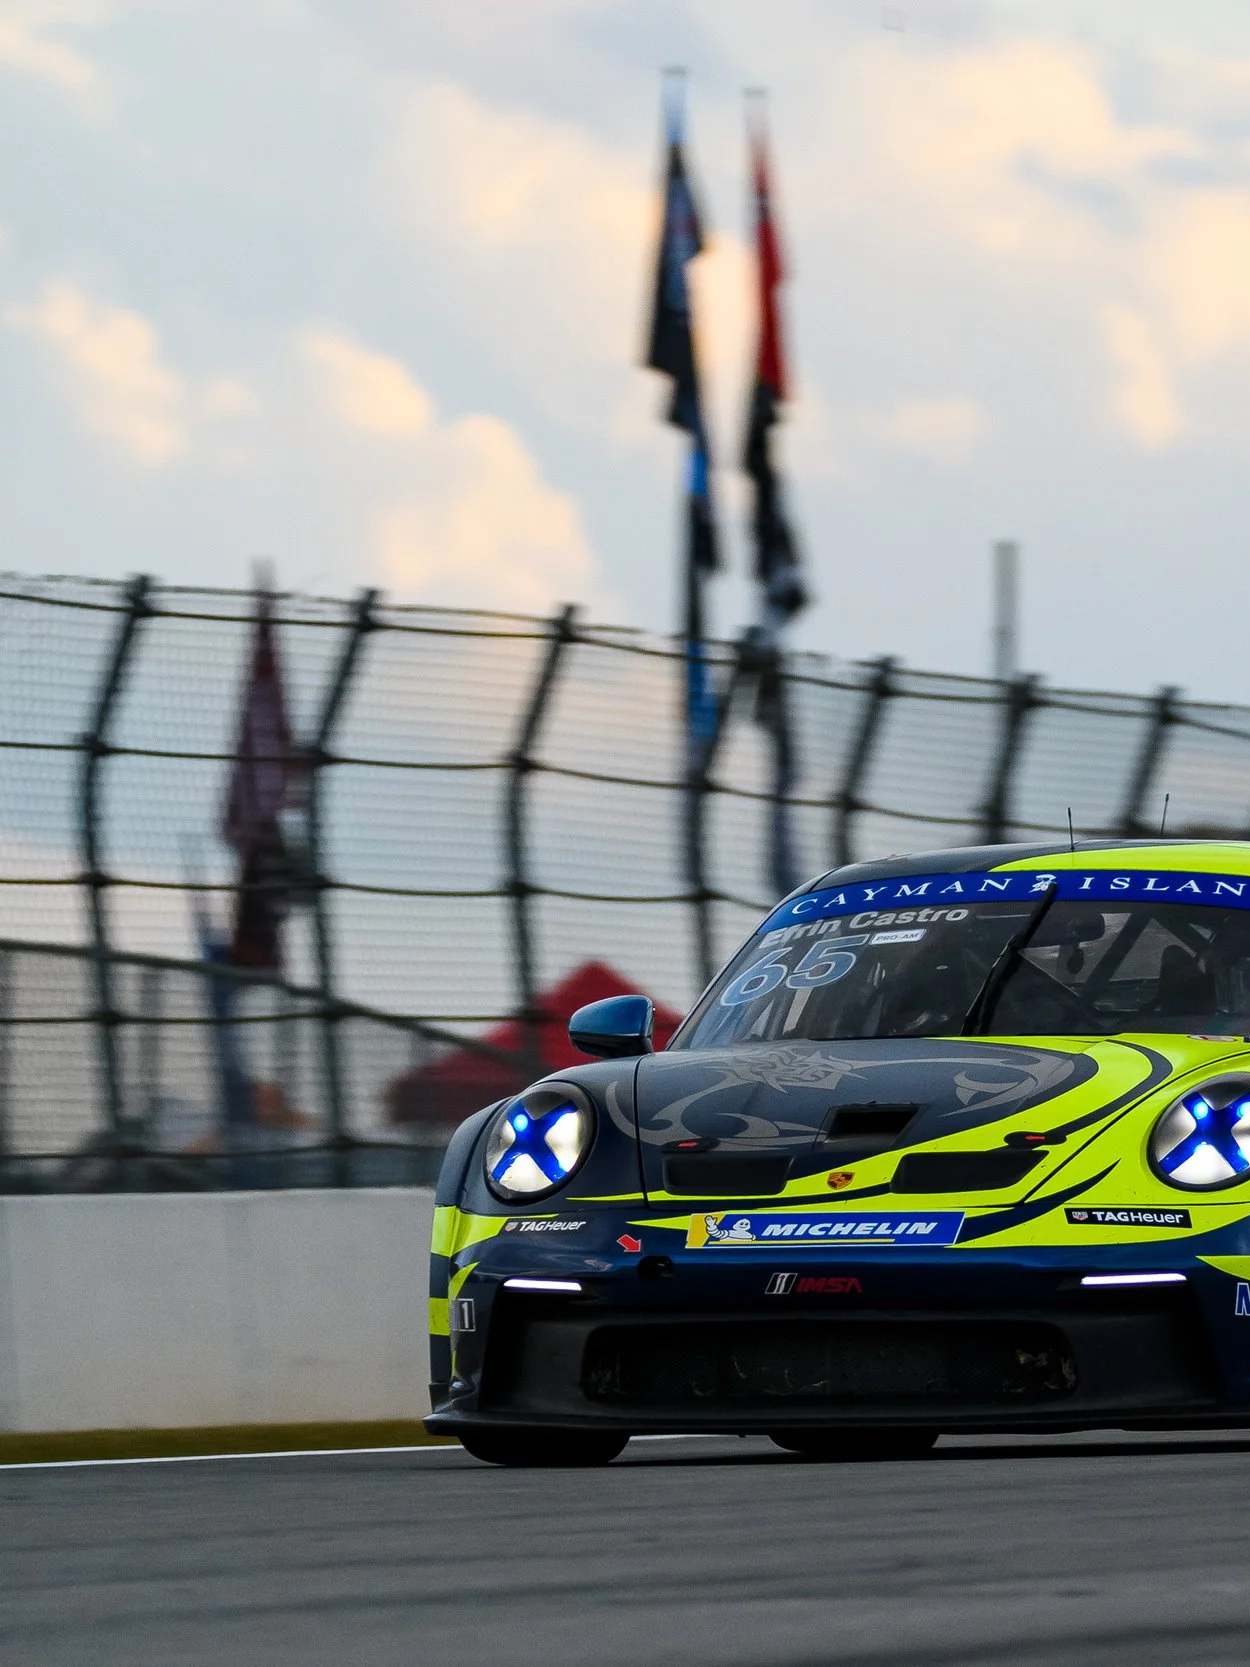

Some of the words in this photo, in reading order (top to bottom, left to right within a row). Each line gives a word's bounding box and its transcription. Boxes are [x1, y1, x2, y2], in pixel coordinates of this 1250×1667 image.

[791, 878, 1013, 915] CAYMAN
[849, 908, 970, 929] Castro
[720, 934, 870, 1006] 65
[761, 1222, 938, 1236] MICHELIN
[796, 1277, 863, 1293] IMSA
